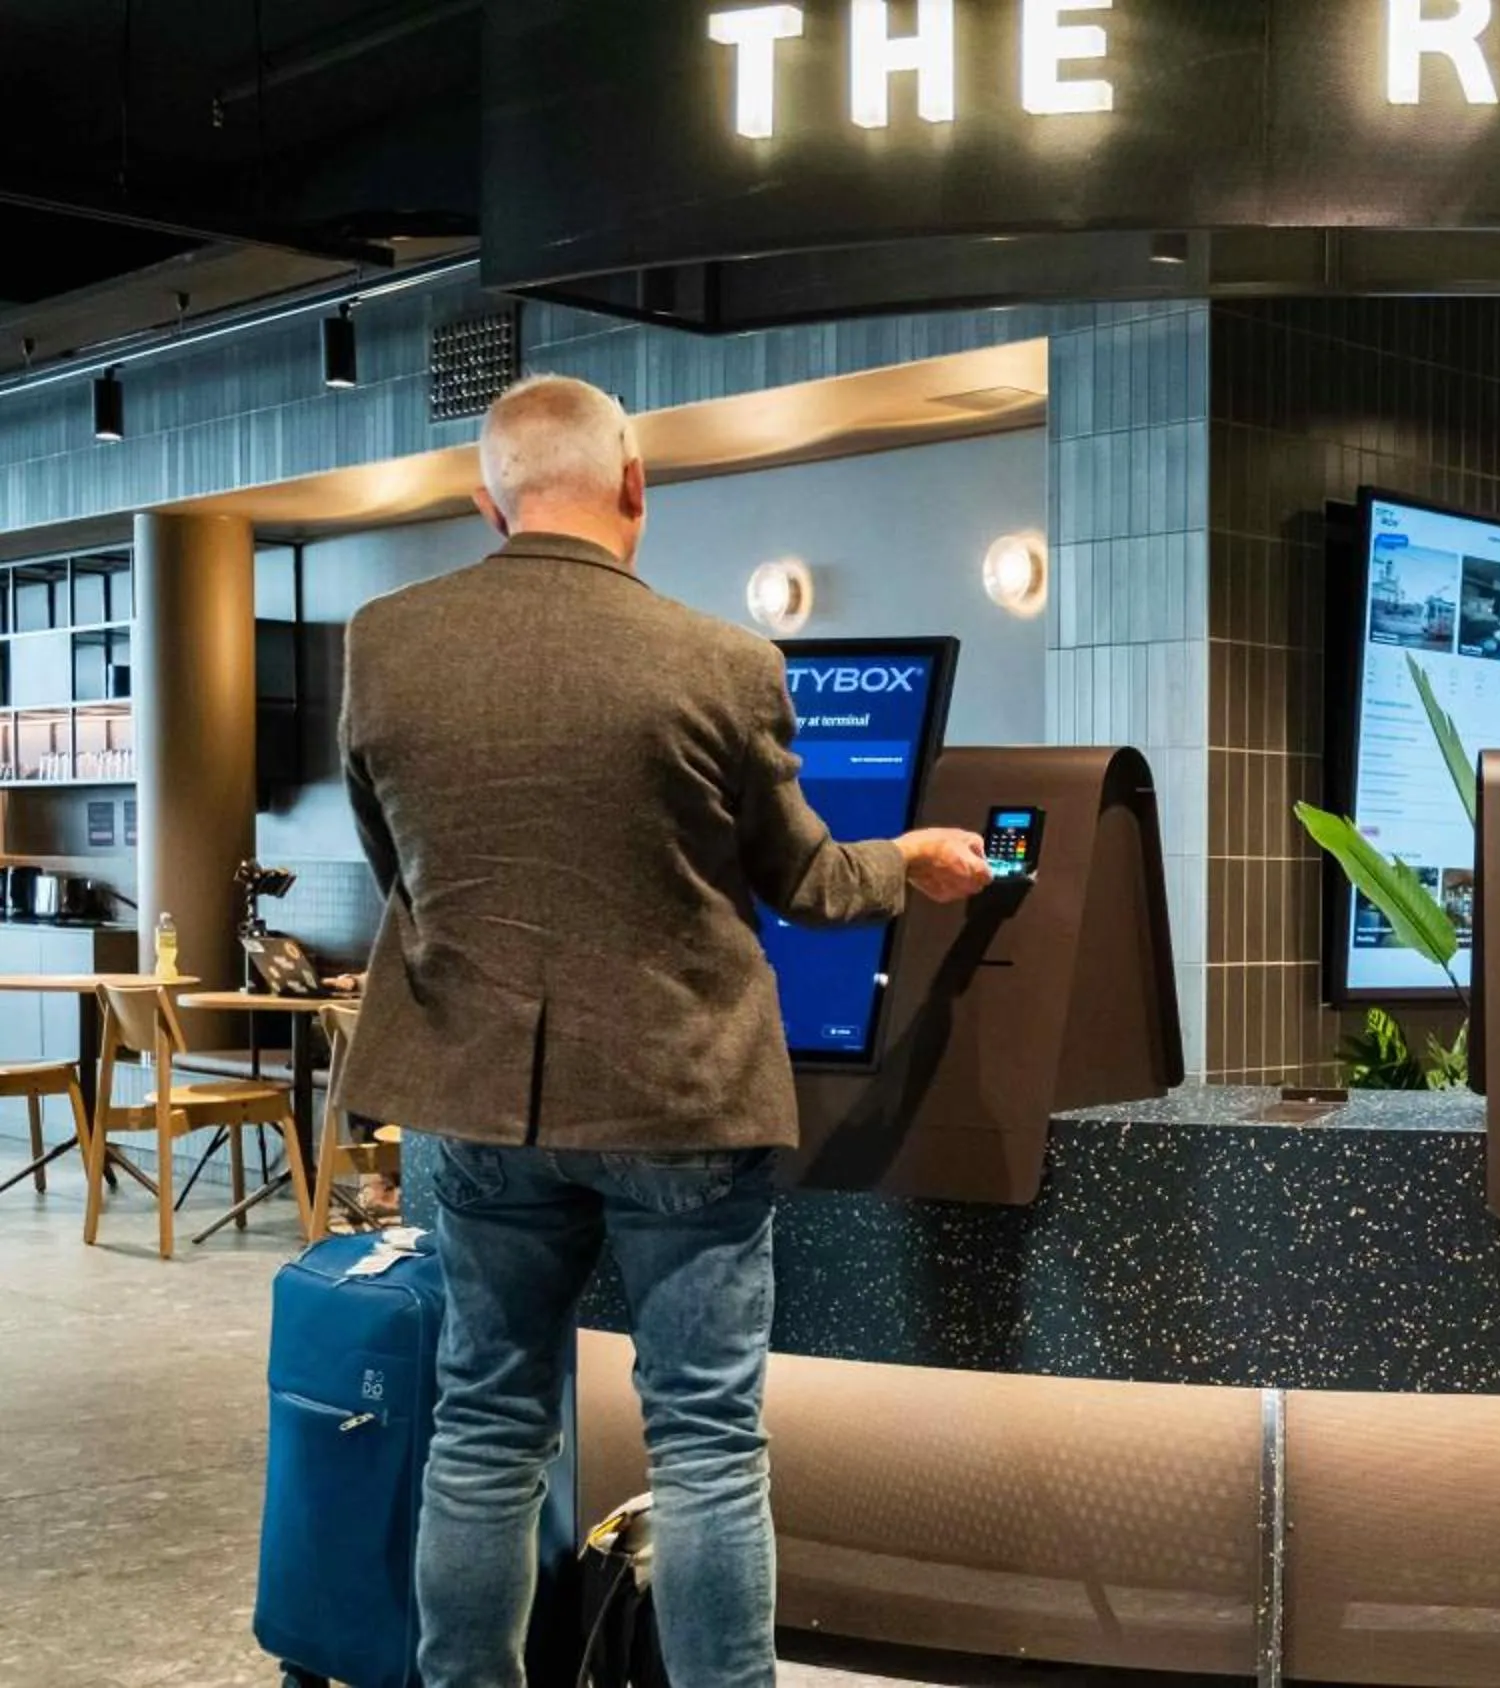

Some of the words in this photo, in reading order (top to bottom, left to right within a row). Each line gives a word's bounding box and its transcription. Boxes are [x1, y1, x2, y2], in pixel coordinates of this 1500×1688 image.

[708, 0, 1114, 139] THE
[786, 667, 916, 693] TYBOX
[822, 712, 871, 727] terminal
